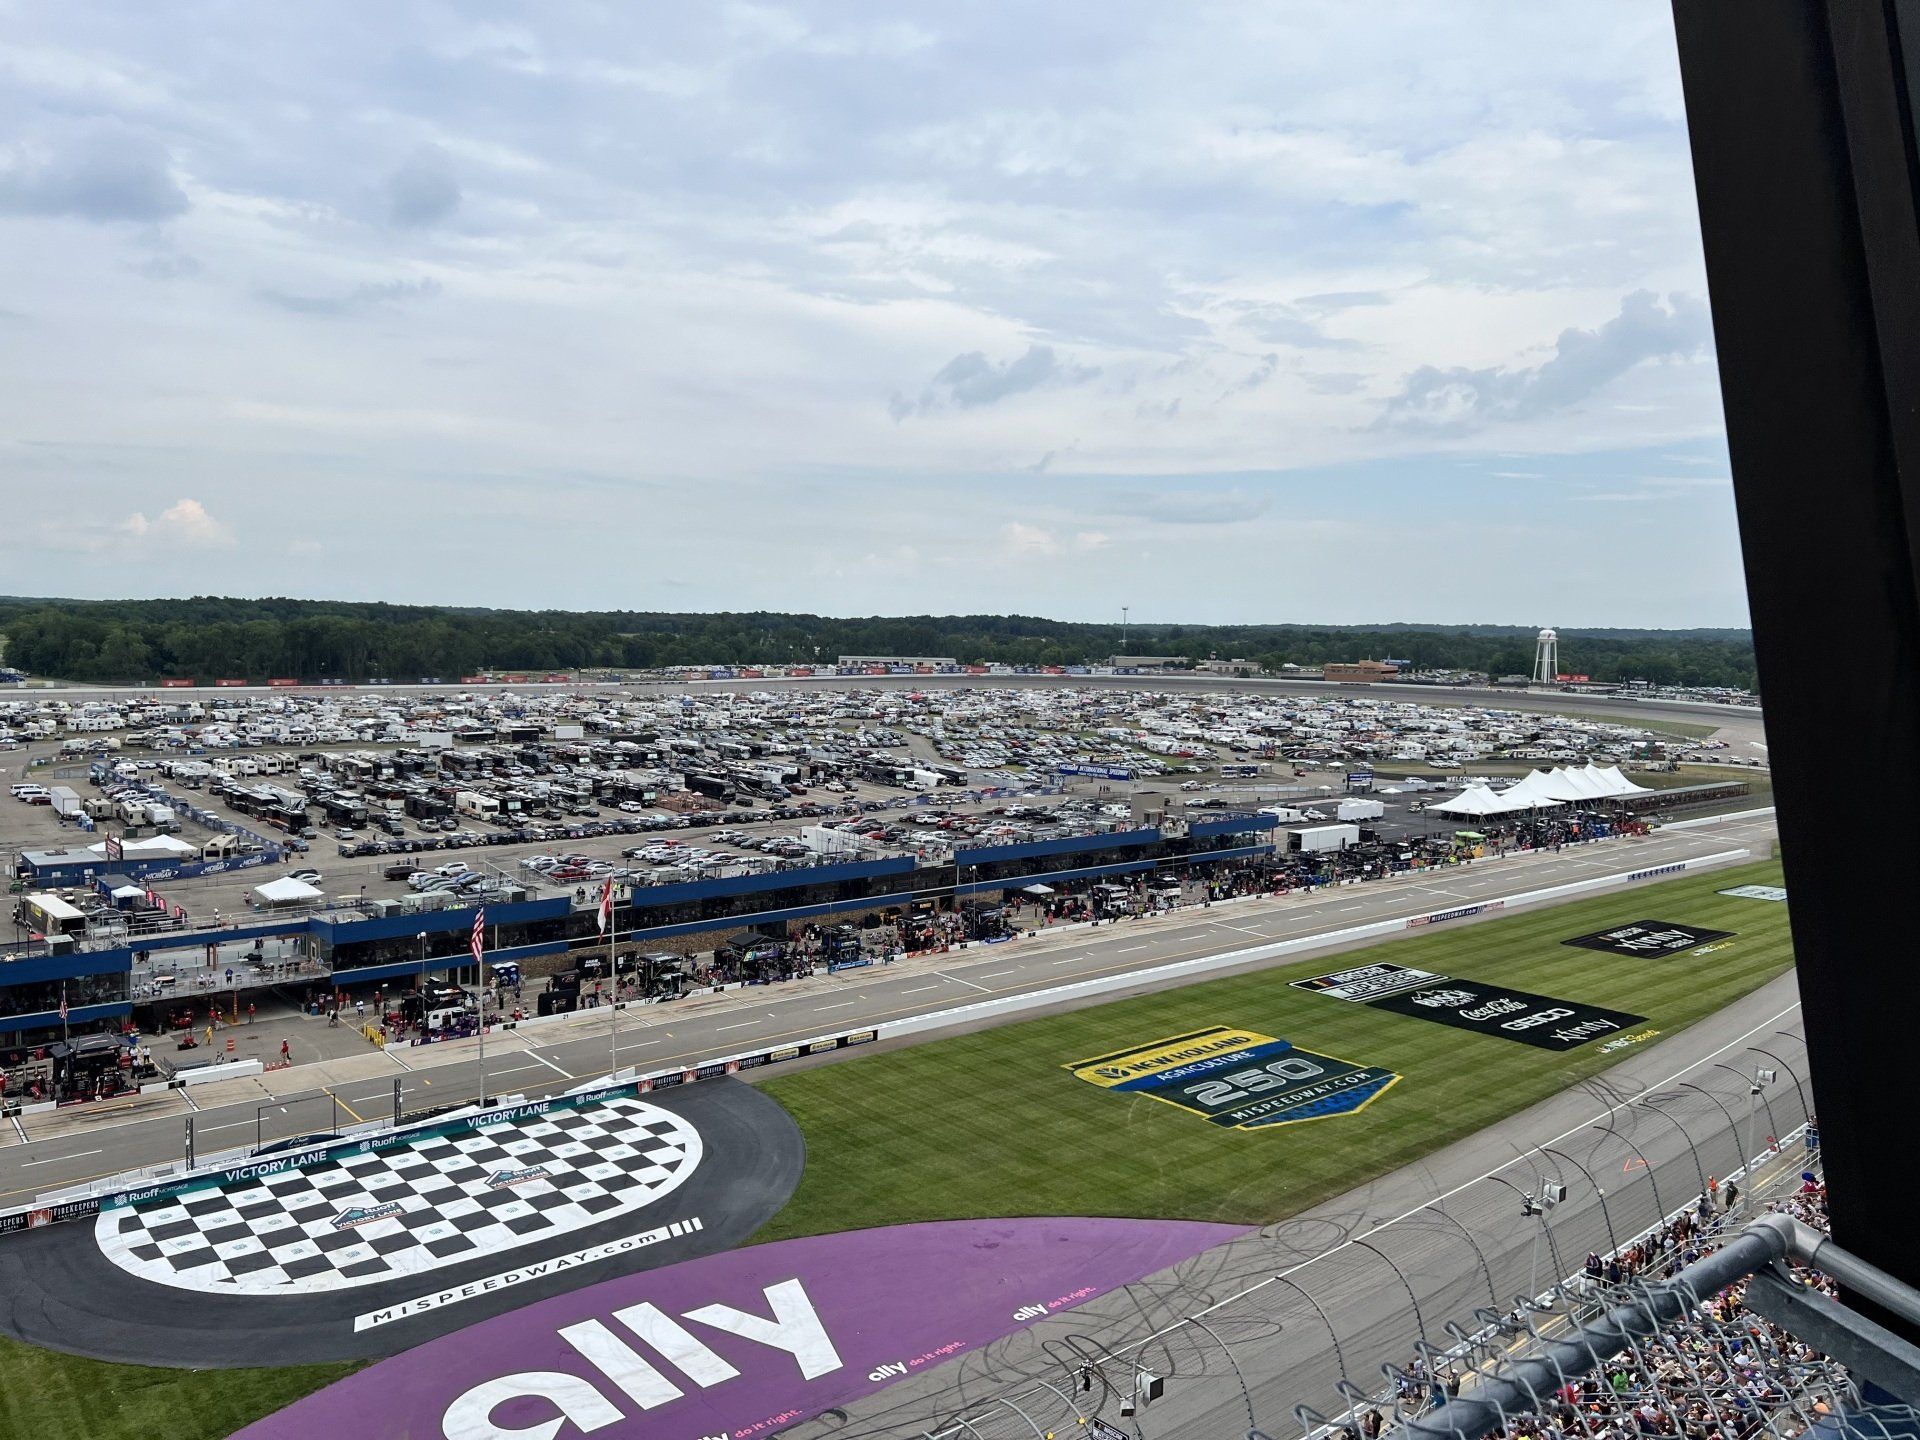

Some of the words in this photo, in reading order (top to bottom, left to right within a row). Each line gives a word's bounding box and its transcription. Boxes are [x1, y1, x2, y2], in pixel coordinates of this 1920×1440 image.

[1059, 763, 1079, 771] MICHIGAN
[1079, 765, 1108, 775] INTERNATIONAL
[1109, 768, 1130, 777] SPEEDWAY
[144, 869, 173, 880] MICHIGAN
[204, 862, 224, 873] MICHIGAN
[1431, 907, 1477, 922] MISPEEDWAY.com
[1615, 929, 1695, 950] xfinity
[1331, 966, 1391, 984] NASCAR
[1340, 981, 1372, 996] CUP
[1459, 998, 1528, 1021] Coca-Cola
[1500, 1008, 1576, 1031] GEICO
[1550, 1019, 1620, 1042] xfinity
[1123, 1053, 1170, 1072] NEW
[1174, 1036, 1250, 1061] HOLLAND
[1155, 1051, 1255, 1081] AGRICULTURE
[1184, 1058, 1324, 1106] 250
[585, 1091, 607, 1102] Ruoff
[1230, 1072, 1371, 1120] MISPEEDWAY.COM
[467, 1107, 518, 1128] VICTORY
[519, 1102, 549, 1118] LANE
[371, 1135, 397, 1149] Ruoff
[396, 1132, 421, 1142] MORTGAGE
[225, 1158, 287, 1182] VICTORY
[290, 1150, 327, 1168] LANE
[512, 1165, 543, 1176] Ruoff
[129, 1187, 160, 1202] Ruoff
[158, 1183, 189, 1195] MORTGAGE
[53, 1200, 99, 1217] FIREKEEPERS
[336, 1213, 377, 1229] VICTORY
[376, 1208, 404, 1219] LANE
[363, 1202, 396, 1215] Ruoff
[373, 1233, 657, 1324] MISPEEDWAY.com
[1013, 1303, 1049, 1321] ally
[1048, 1301, 1061, 1309] do
[1061, 1296, 1071, 1304] it
[1071, 1286, 1097, 1301] right.
[442, 1278, 844, 1440] ally
[868, 1361, 908, 1382] ally
[909, 1357, 925, 1367] do
[924, 1352, 935, 1362] it
[934, 1340, 966, 1358] right.
[735, 1429, 752, 1439] do
[752, 1421, 766, 1431] it
[766, 1409, 804, 1428] right.
